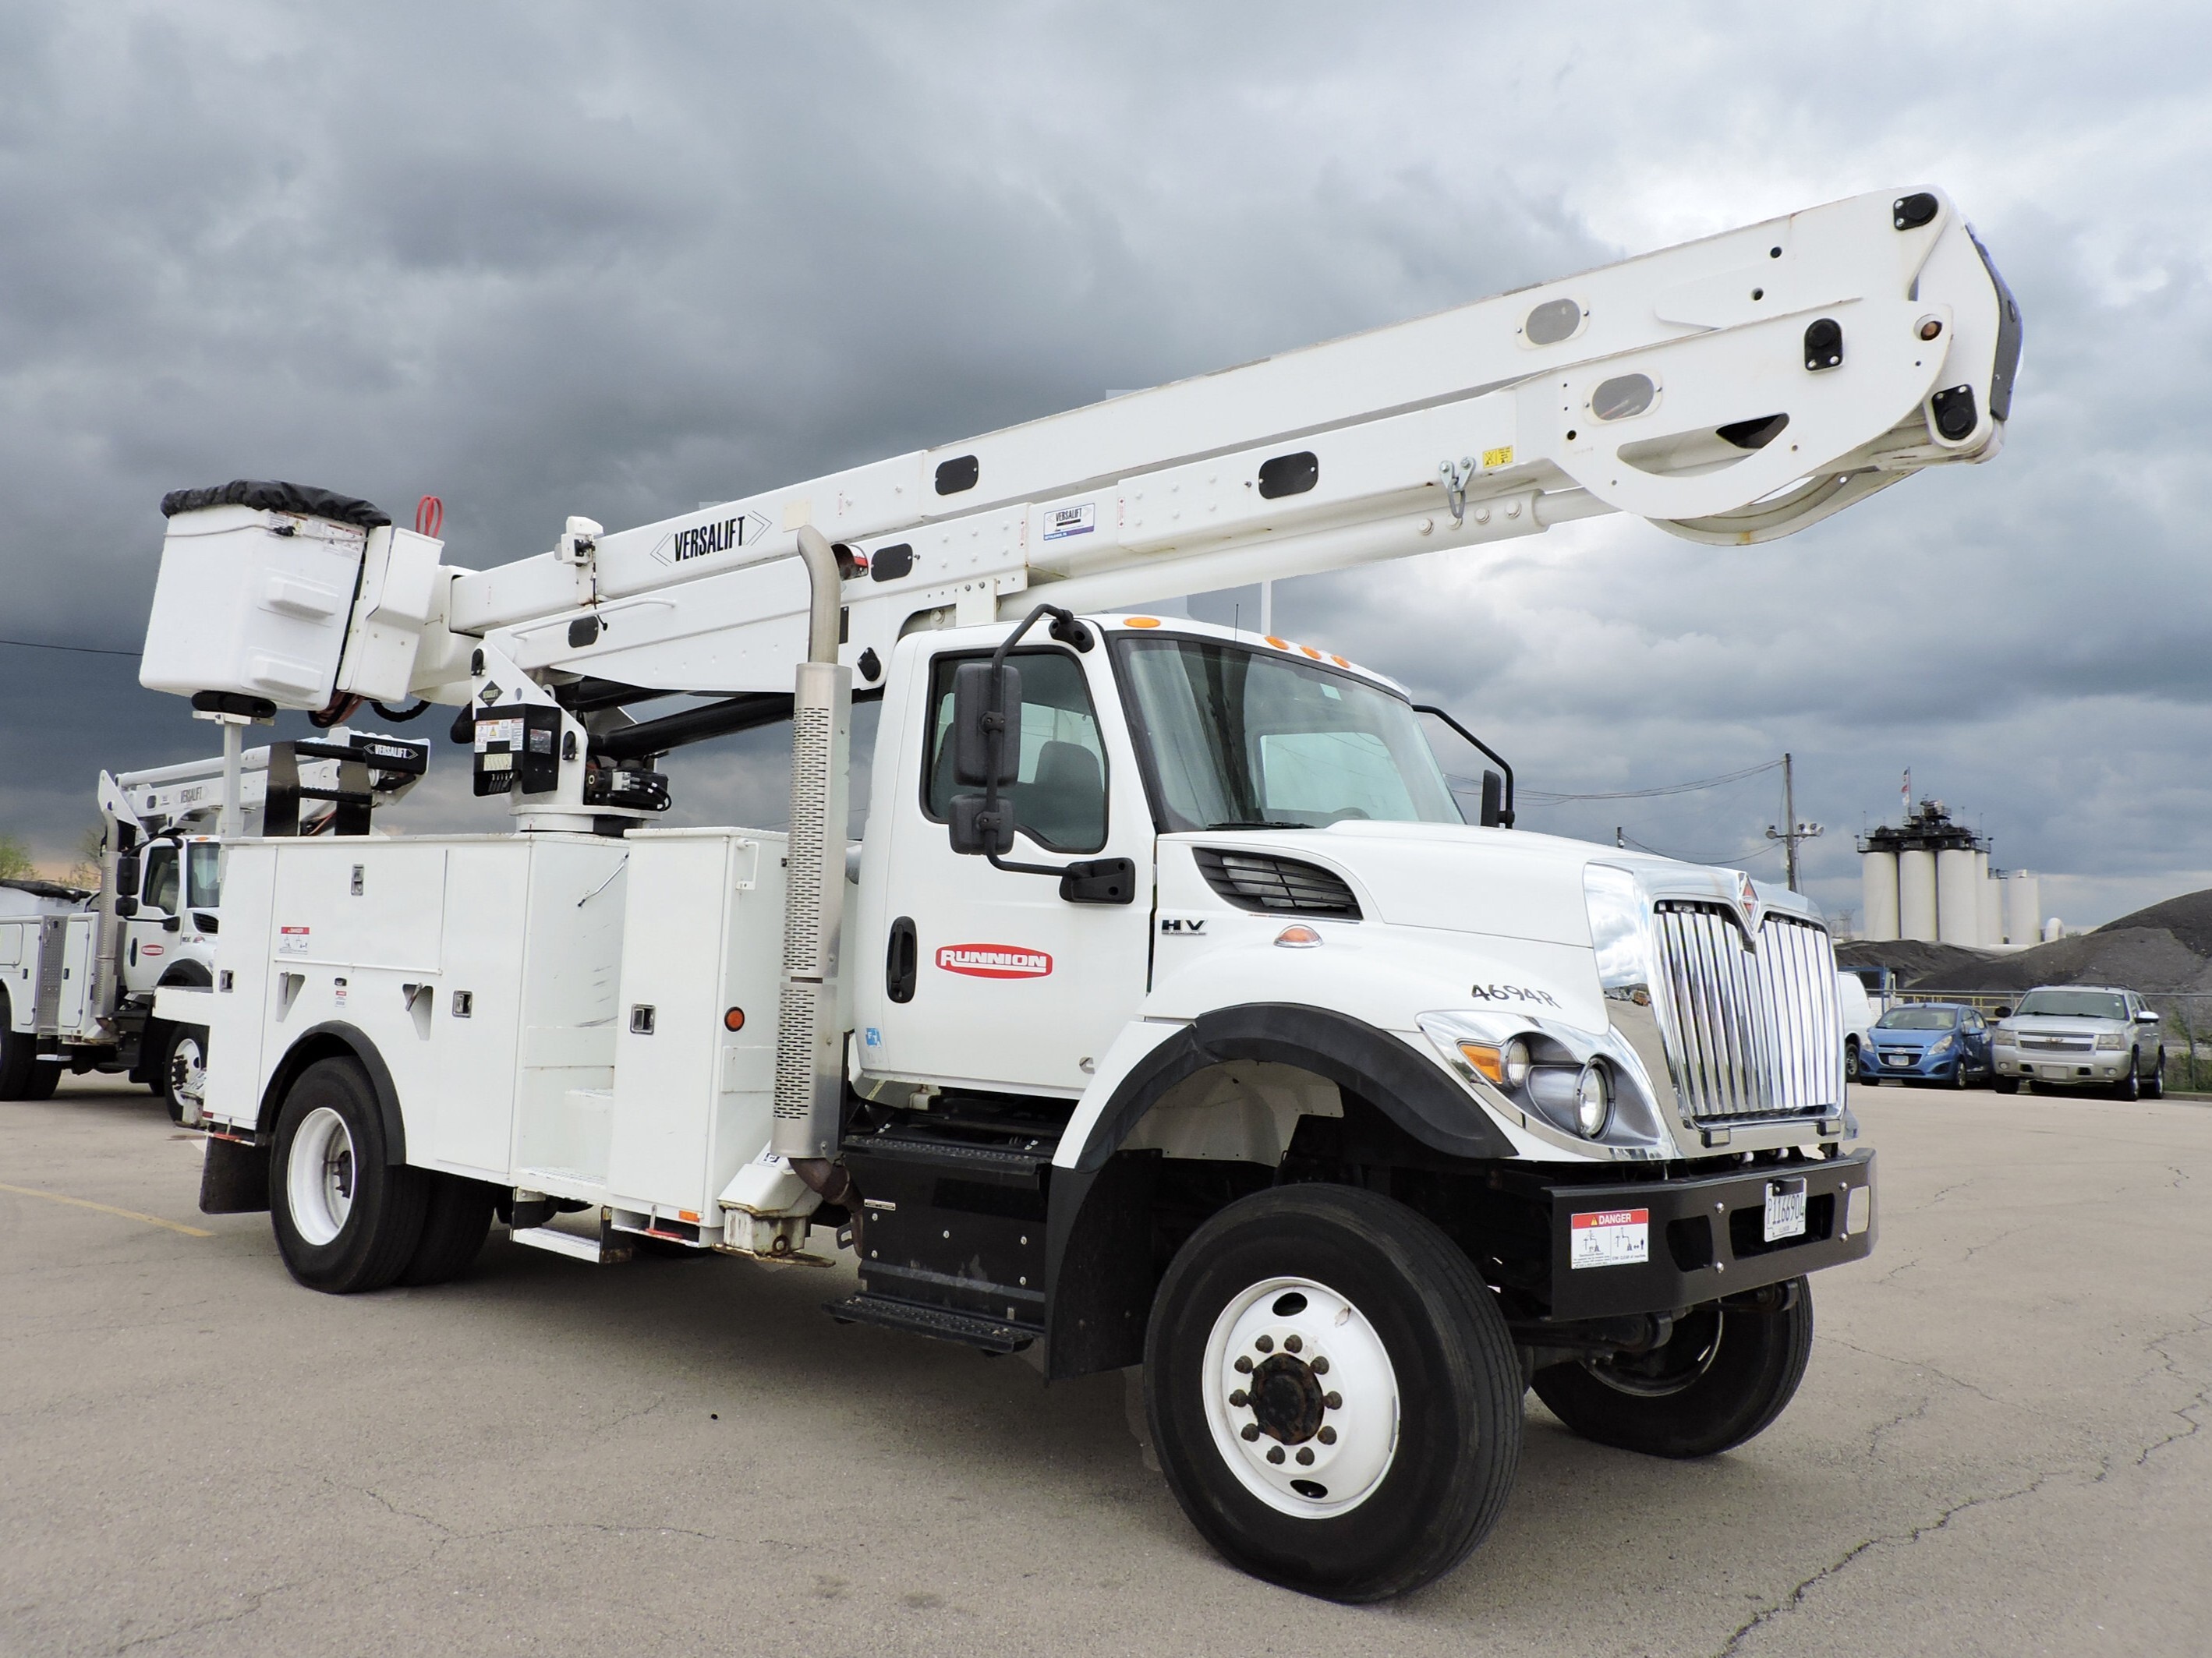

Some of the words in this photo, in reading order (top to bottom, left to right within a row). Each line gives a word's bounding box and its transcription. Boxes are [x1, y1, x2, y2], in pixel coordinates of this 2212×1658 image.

[1056, 507, 1082, 521] VERSALIFT
[674, 515, 745, 562] VERSALIFT
[374, 744, 409, 758] VERSALIFT
[180, 787, 203, 803] VERSALIFT
[1162, 920, 1205, 930] HV
[940, 949, 1046, 970] RUNNION
[1471, 985, 1563, 1009] 4694R
[1598, 1213, 1632, 1225] DANGER
